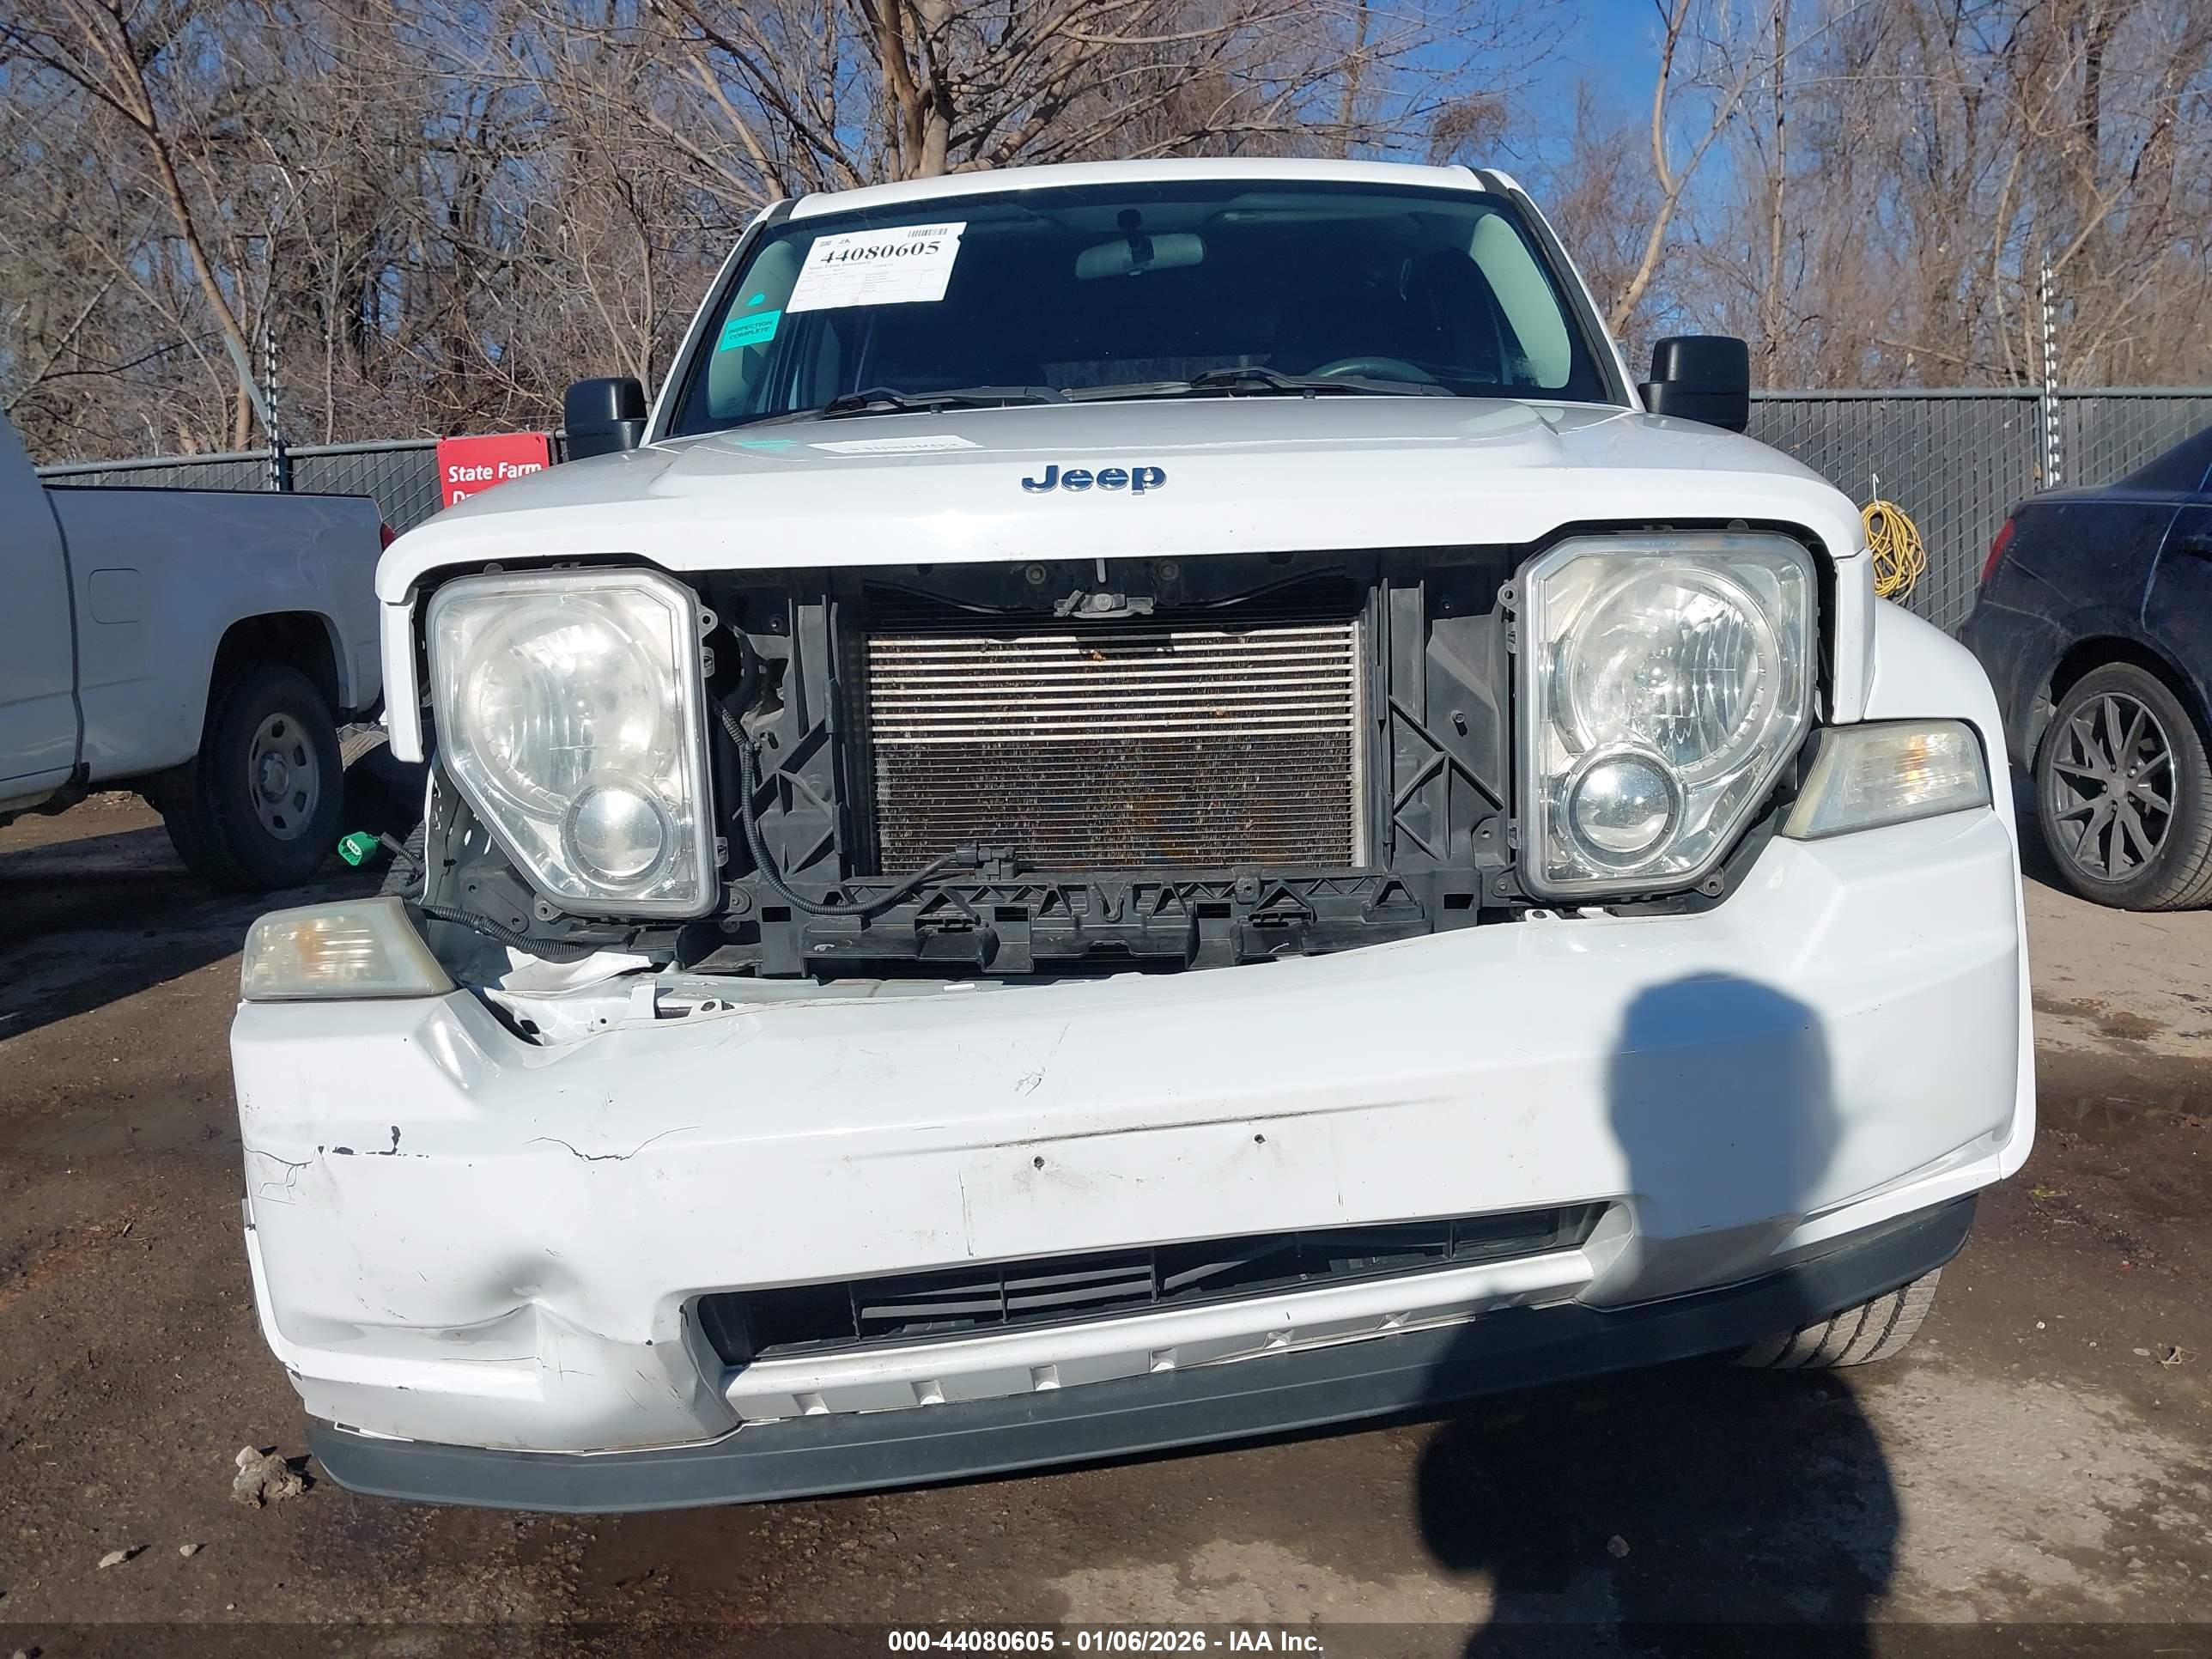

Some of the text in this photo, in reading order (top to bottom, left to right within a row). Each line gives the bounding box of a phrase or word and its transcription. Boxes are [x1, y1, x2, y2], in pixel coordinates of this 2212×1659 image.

[821, 240, 942, 264] 44080605
[728, 319, 774, 334] INSPECTION
[729, 327, 769, 340] COMPLETE
[448, 462, 542, 483] State Farm
[1021, 465, 1168, 495] Jeep
